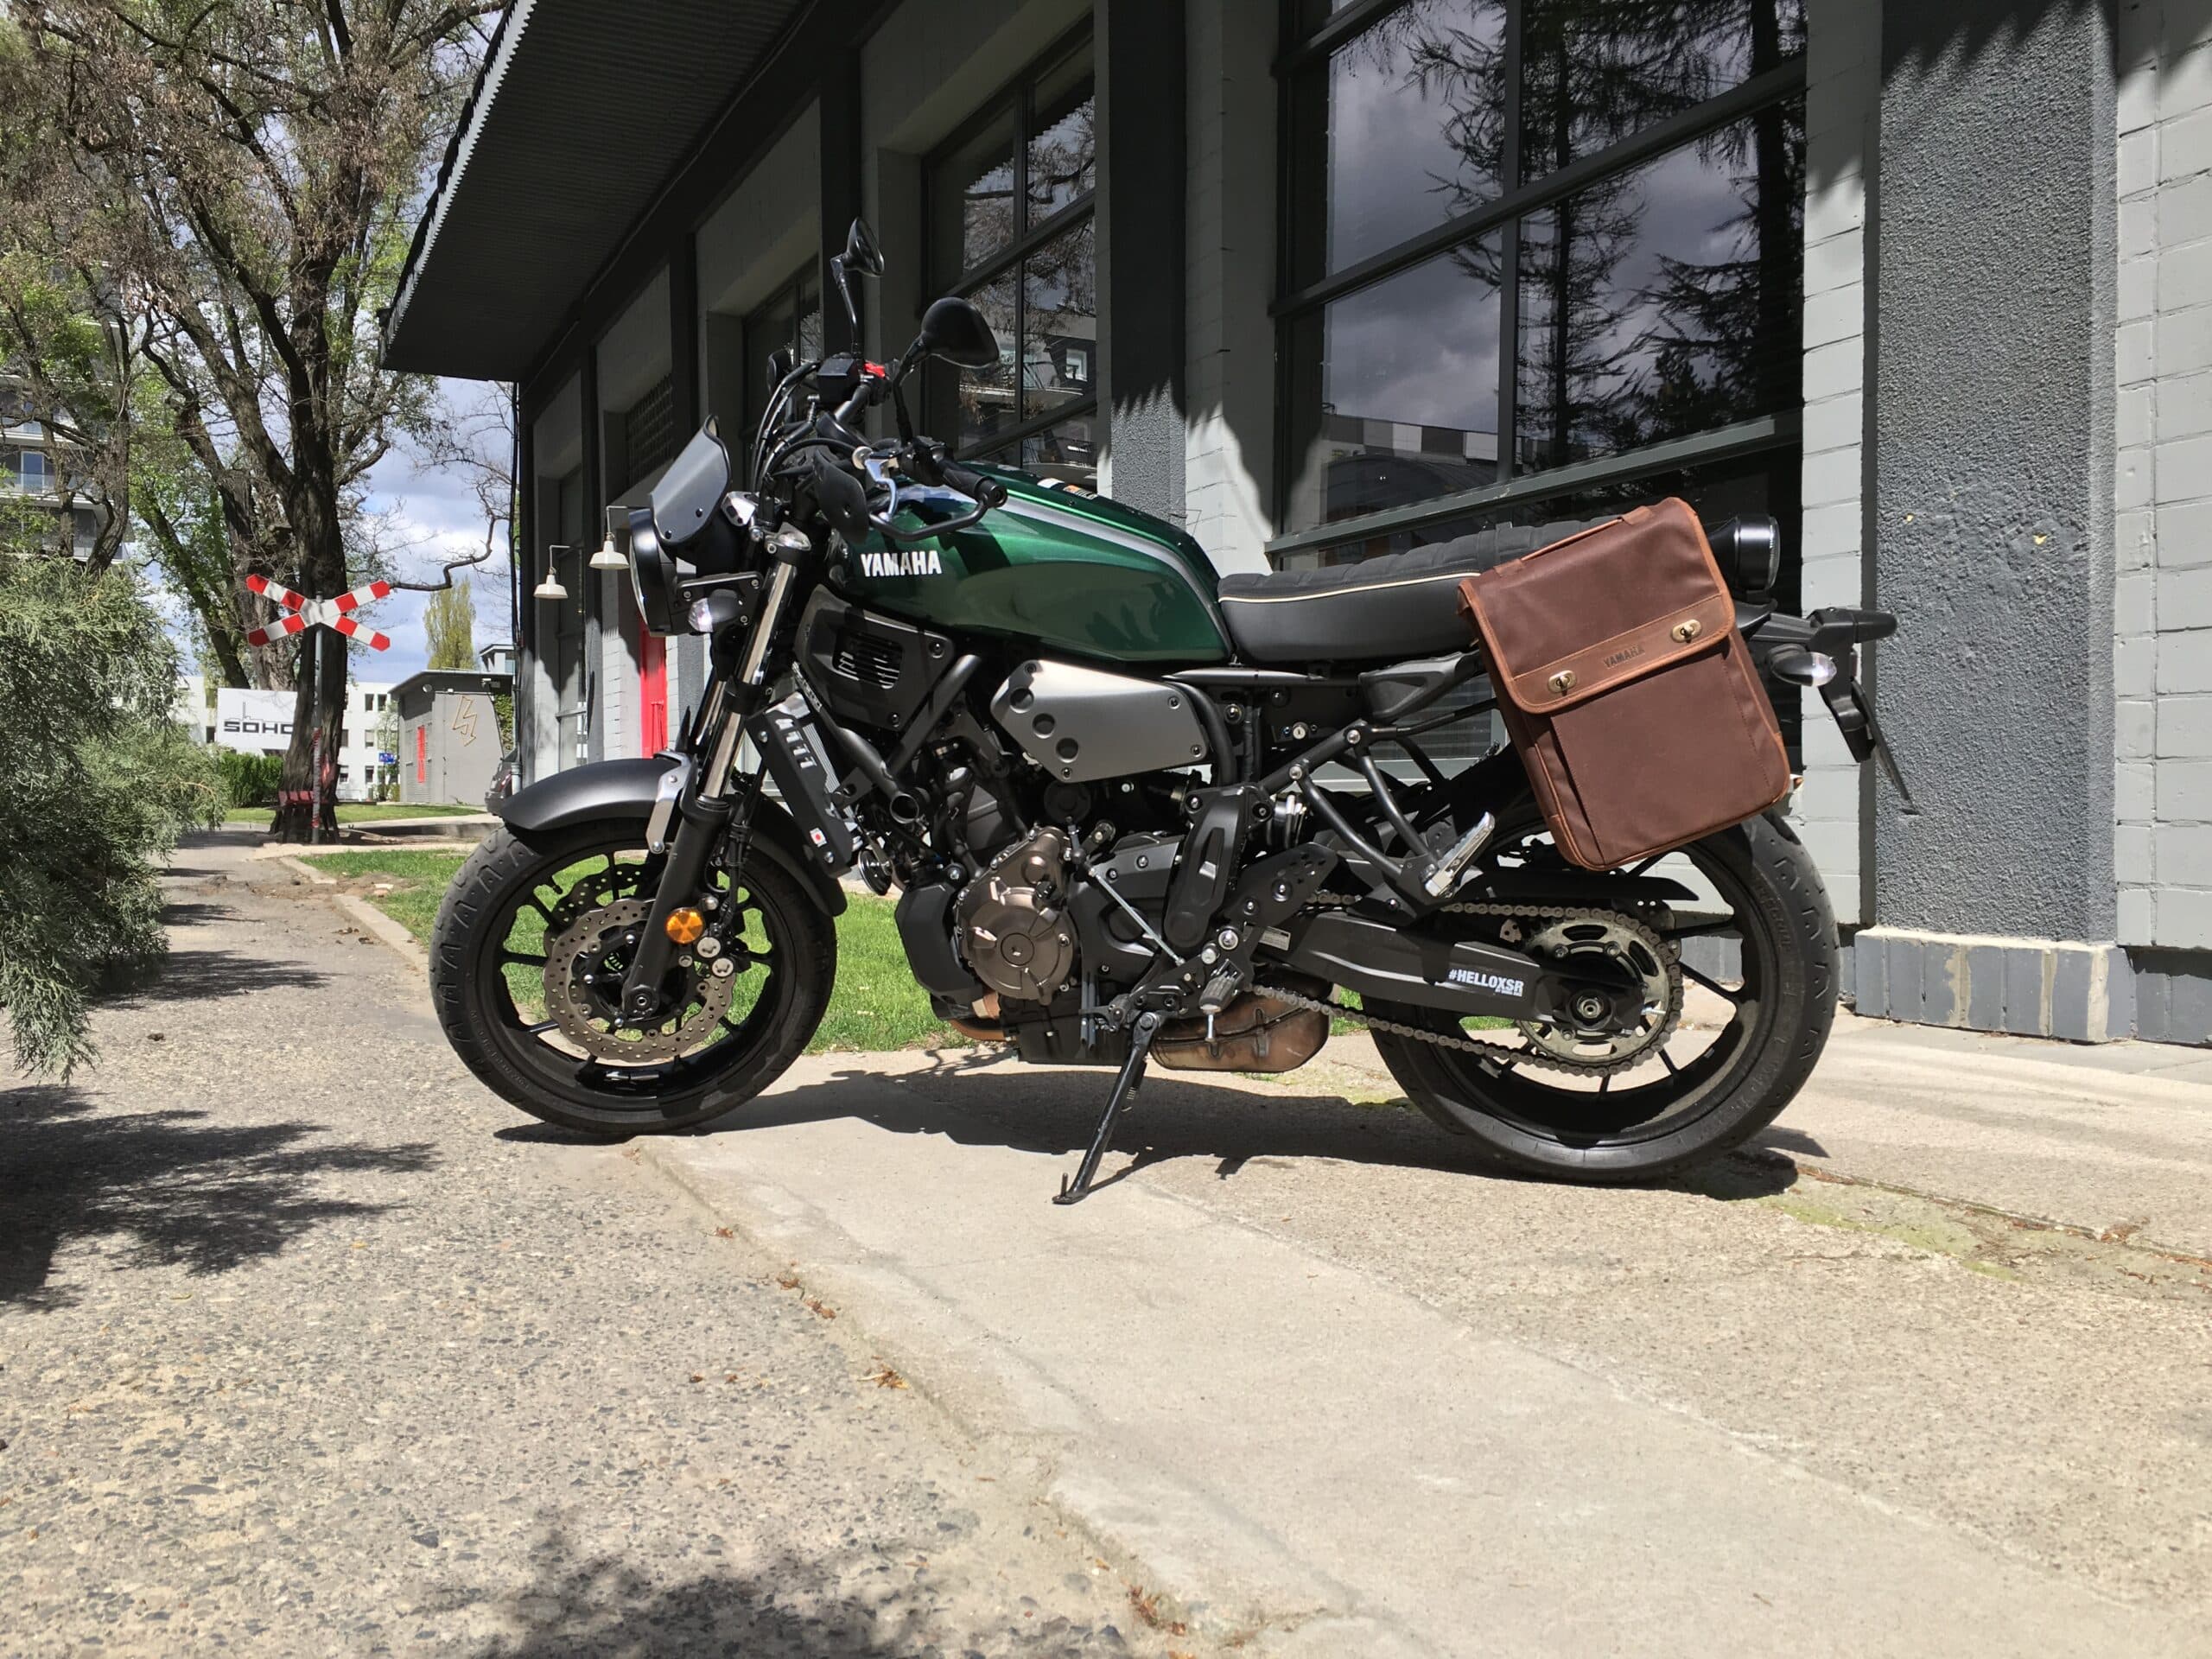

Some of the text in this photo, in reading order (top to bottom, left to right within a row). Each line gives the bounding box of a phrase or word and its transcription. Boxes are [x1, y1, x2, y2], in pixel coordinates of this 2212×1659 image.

[861, 550, 942, 577] YAMAHA
[1604, 645, 1646, 669] YAMAHA
[1448, 969, 1524, 993] #HELLOXSR
